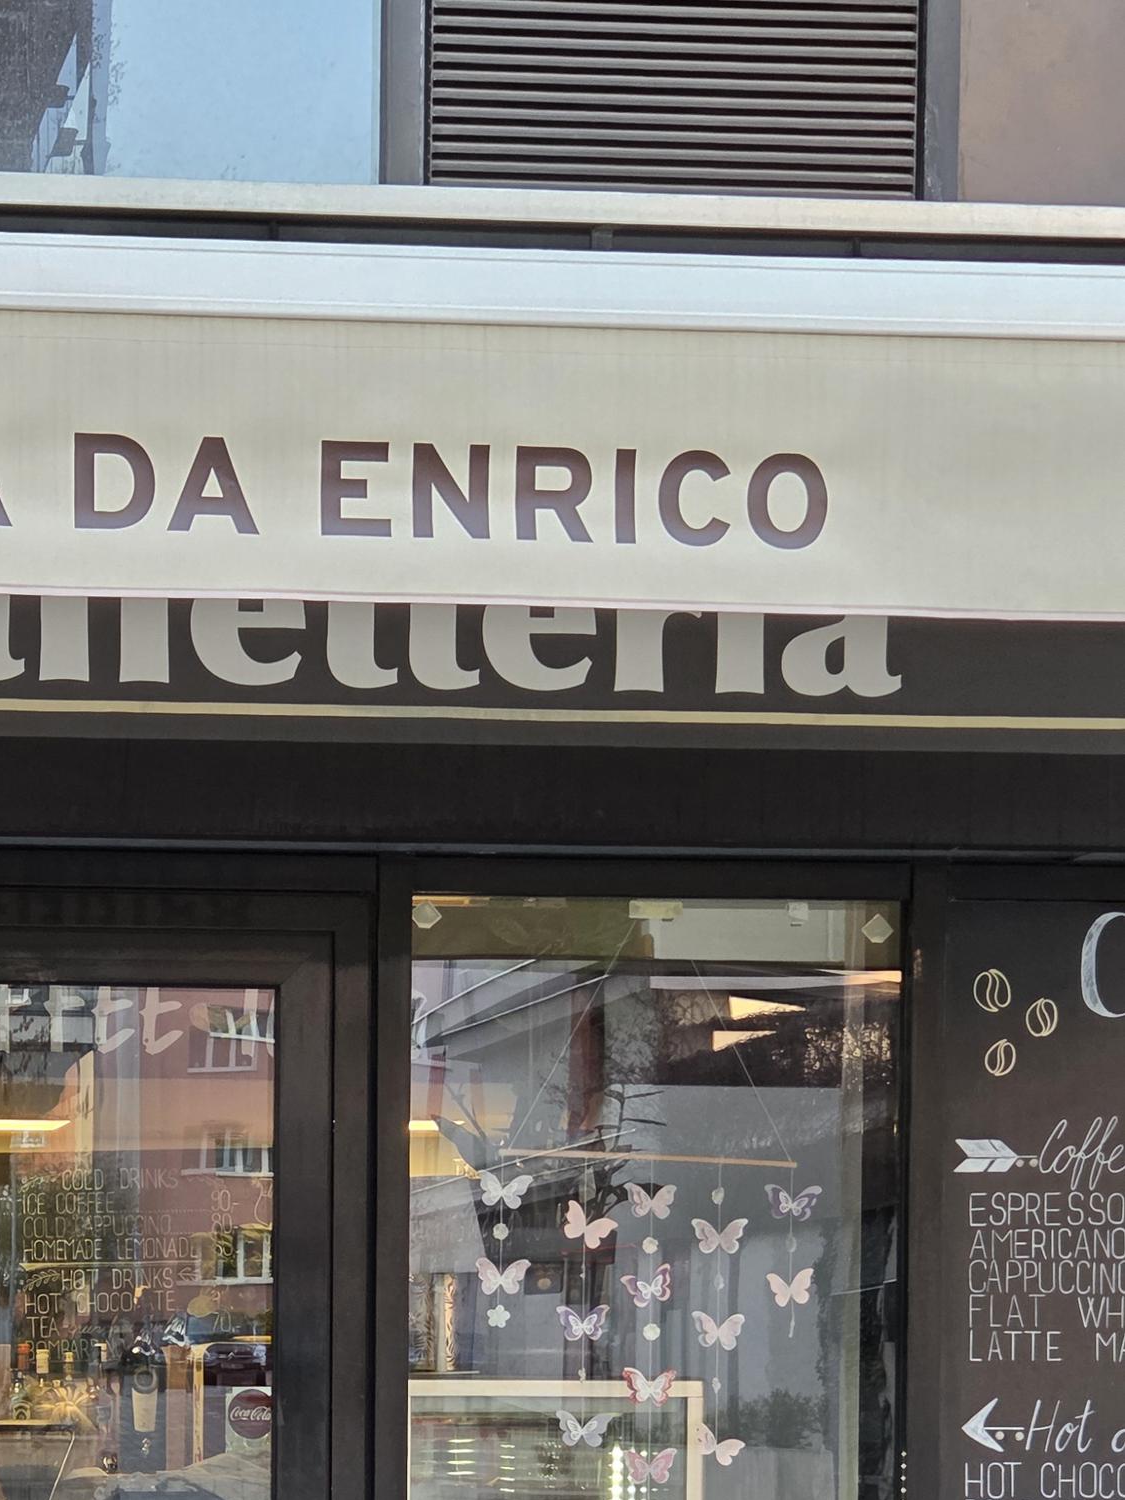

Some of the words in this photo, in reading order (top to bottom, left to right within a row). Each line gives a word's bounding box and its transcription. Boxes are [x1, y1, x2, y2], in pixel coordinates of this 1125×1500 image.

[75, 432, 260, 537] DA
[319, 439, 828, 551] ENRICO
[62, 1169, 104, 1191] COLD
[120, 1168, 179, 1190] DRINKS
[56, 1191, 115, 1214] COFFEE
[969, 1191, 1125, 1226] ESPRESSO
[969, 1227, 1125, 1260] AMERICANO
[24, 1293, 61, 1314] HOT
[77, 1291, 177, 1313] CHOCOTE
[969, 1294, 1046, 1328] FLAT
[27, 1316, 60, 1338] TEA
[969, 1329, 1062, 1362] LATTE
[1025, 1399, 1095, 1453] Hot
[964, 1462, 1022, 1499] HOT
